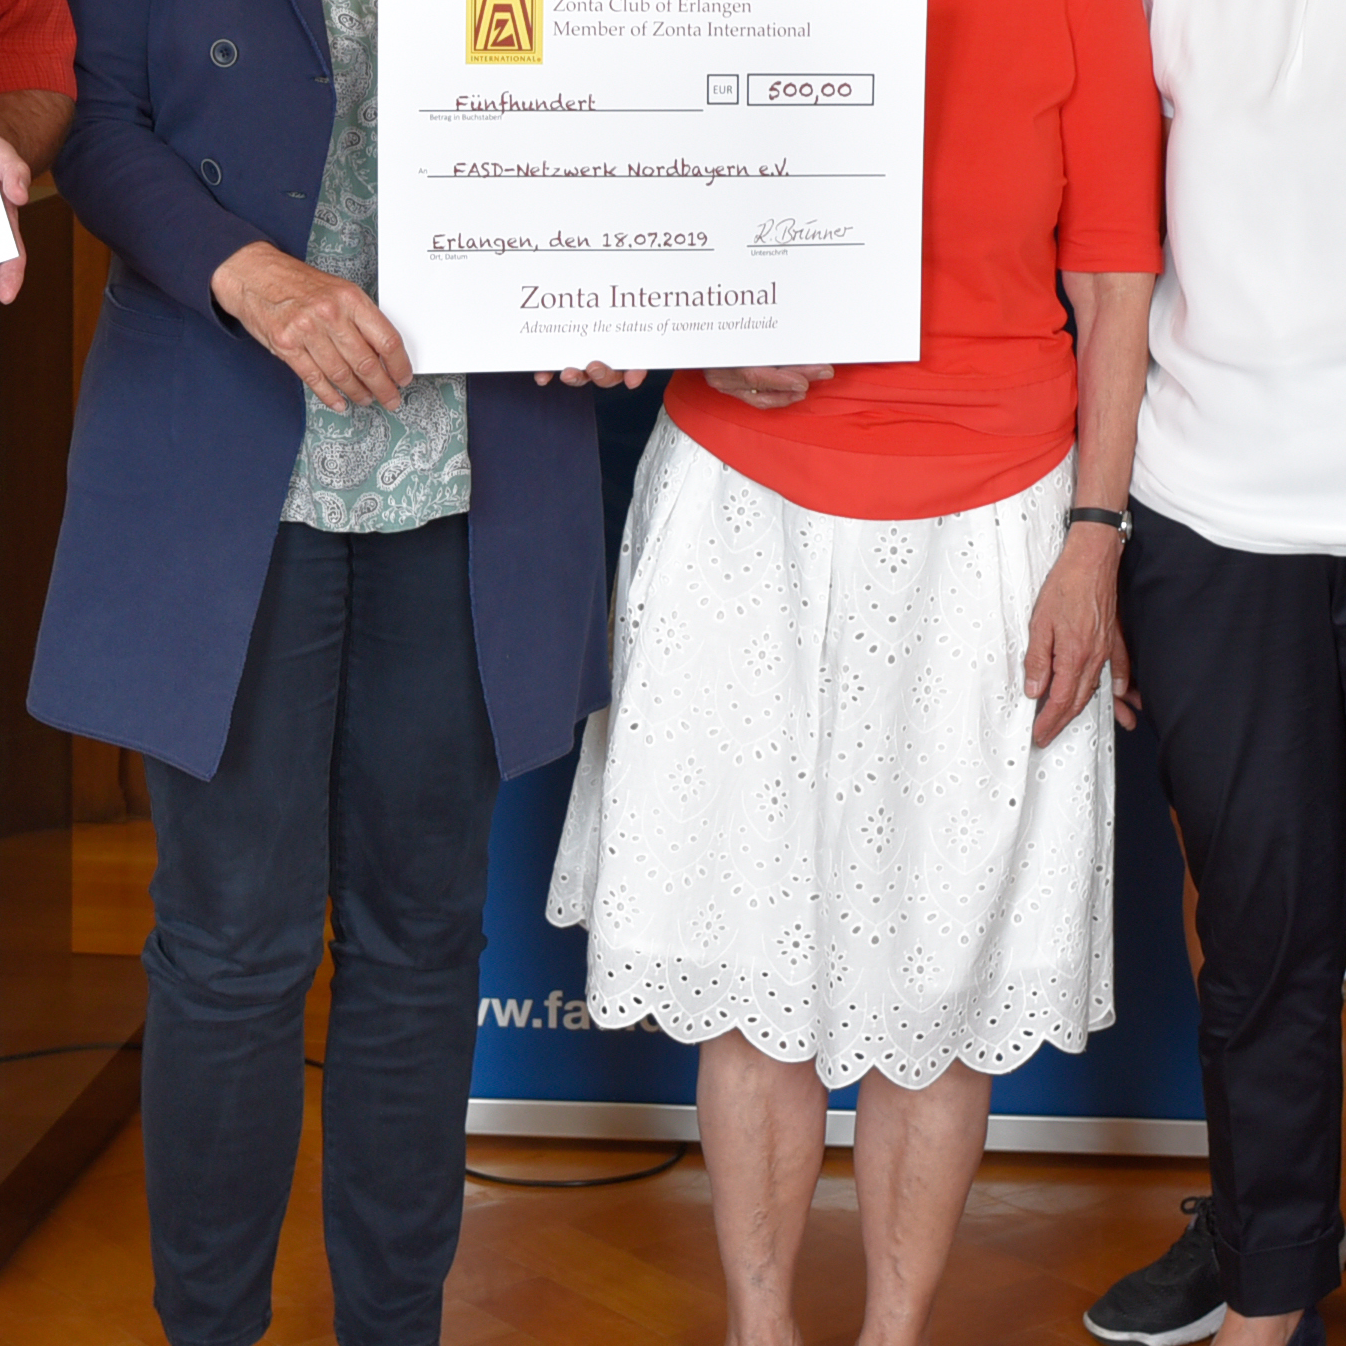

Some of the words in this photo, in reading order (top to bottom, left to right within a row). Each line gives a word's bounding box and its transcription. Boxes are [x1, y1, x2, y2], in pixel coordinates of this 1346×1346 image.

[553, 20, 625, 37] Member
[630, 20, 648, 37] of
[653, 20, 702, 38] Zonta
[707, 22, 811, 38] International
[713, 85, 733, 95] EUR
[768, 80, 853, 104] 500,00
[455, 91, 596, 115] Fünfhundert
[429, 113, 452, 123] Betrag
[454, 113, 460, 121] in
[462, 113, 502, 121] Buchstaben
[453, 160, 617, 177] FASD-Netzwerk
[628, 157, 749, 186] Nordbayern
[759, 157, 789, 176] e.V.
[432, 232, 539, 255] Erlangen,
[549, 230, 591, 249] den
[603, 232, 708, 248] 18.07.2019
[750, 249, 788, 257] Unterschrift
[429, 253, 442, 262] Ort,
[445, 253, 468, 261] Datum
[520, 285, 600, 309] Zonta
[609, 281, 777, 308] International
[520, 320, 588, 337] Advancing
[593, 320, 612, 333] the
[615, 319, 653, 333] status
[656, 318, 671, 336] of
[672, 319, 714, 332] women
[718, 316, 778, 331] worldwide
